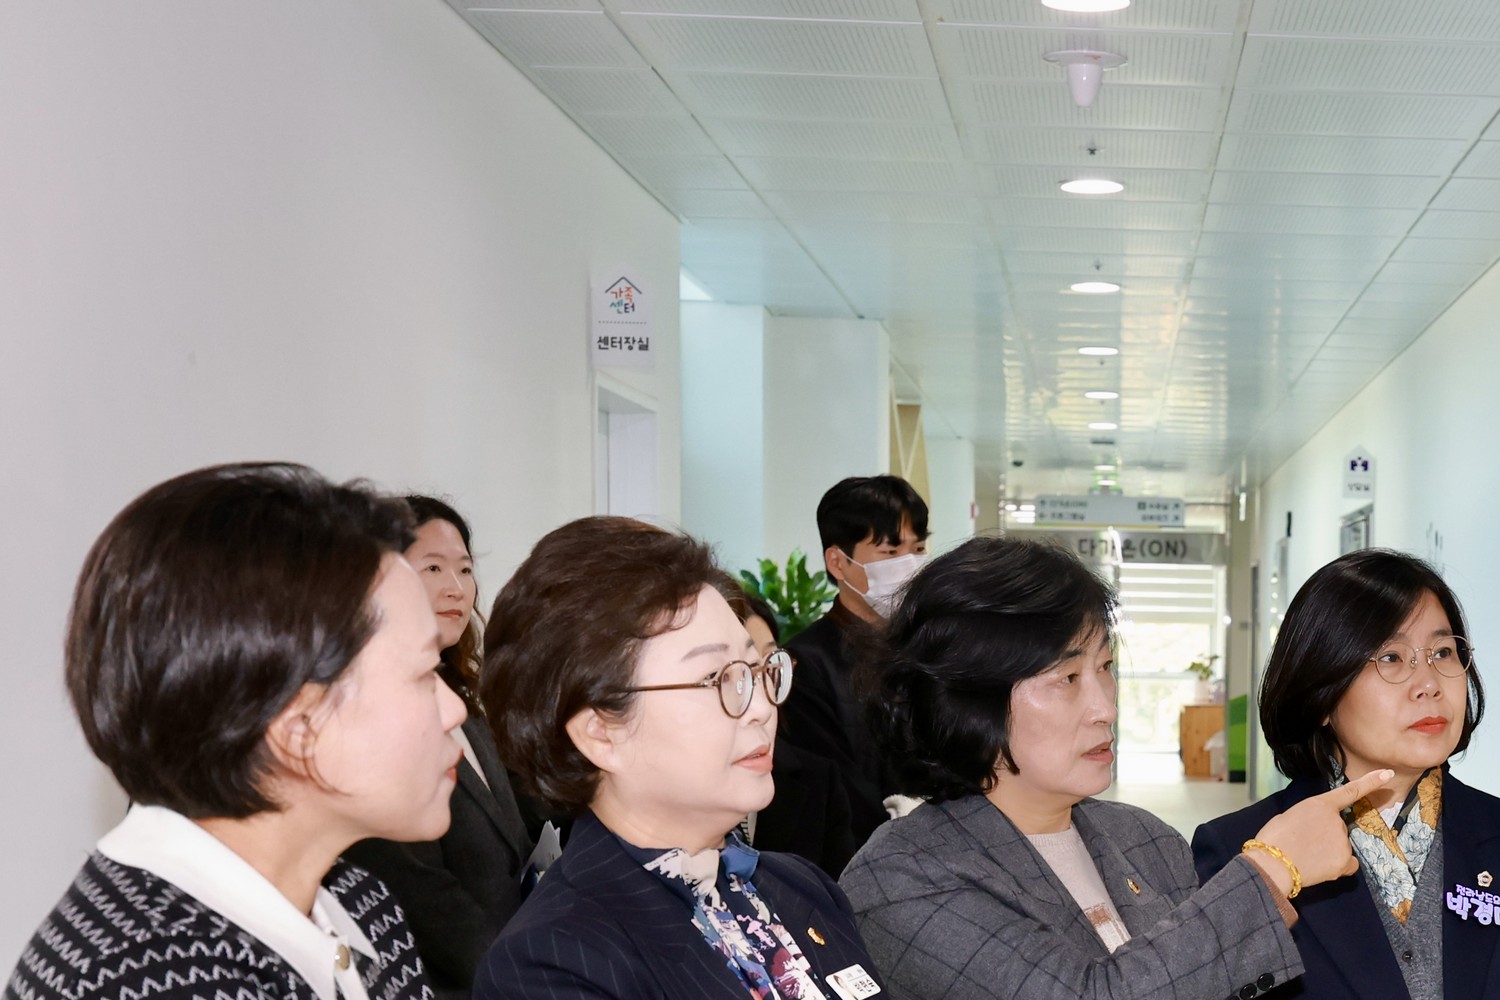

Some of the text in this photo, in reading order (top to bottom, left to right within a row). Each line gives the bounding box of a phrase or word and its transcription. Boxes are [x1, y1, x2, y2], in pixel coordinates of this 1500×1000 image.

[610, 286, 633, 303] 가족
[609, 299, 635, 314] 센터
[597, 336, 649, 351] 센터장실
